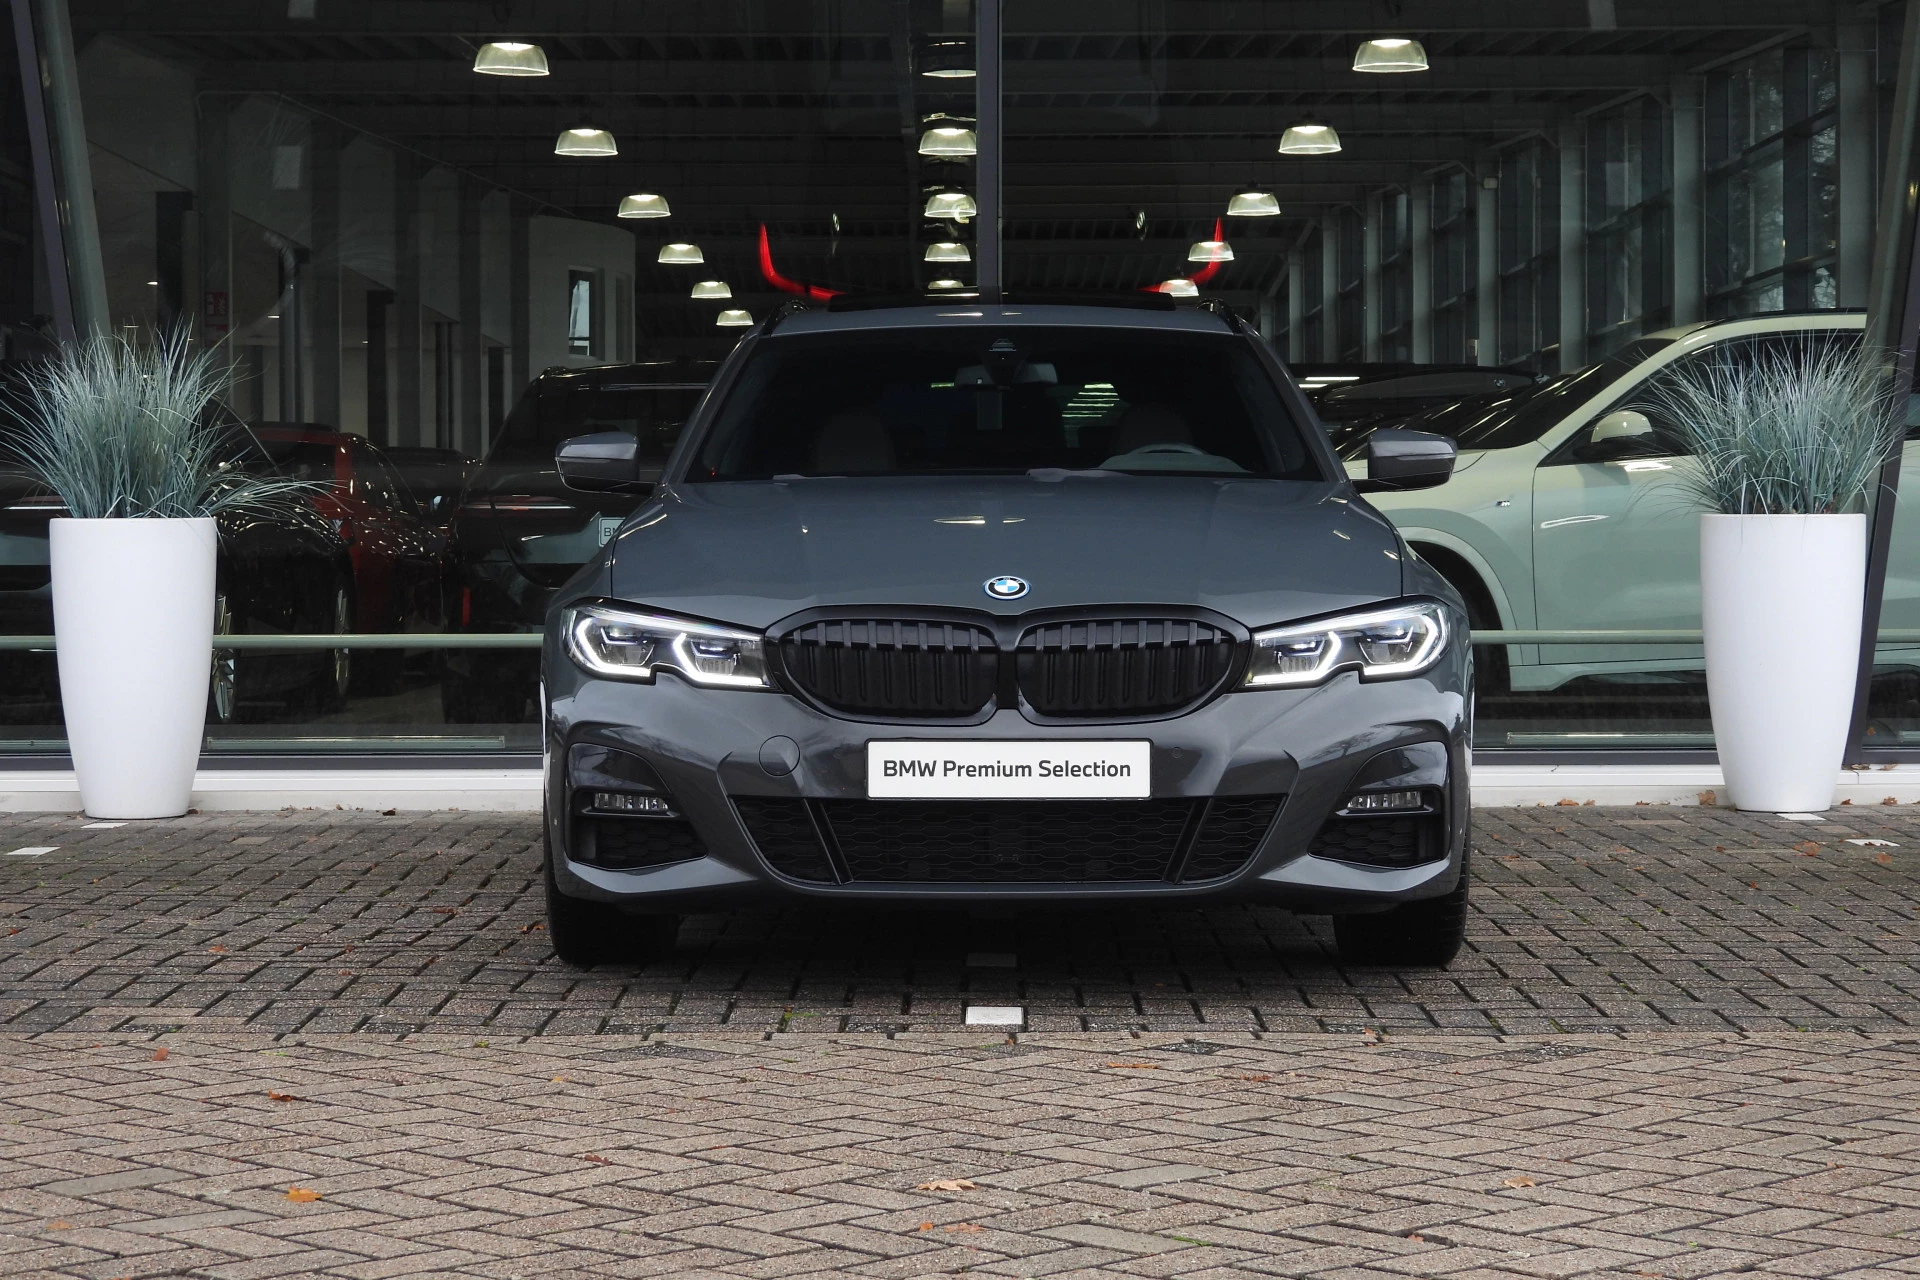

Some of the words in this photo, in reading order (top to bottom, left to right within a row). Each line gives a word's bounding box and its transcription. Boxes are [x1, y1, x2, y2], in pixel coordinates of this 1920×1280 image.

[884, 760, 936, 776] BMW
[944, 760, 1031, 777] Premium
[1039, 760, 1130, 777] Selection
